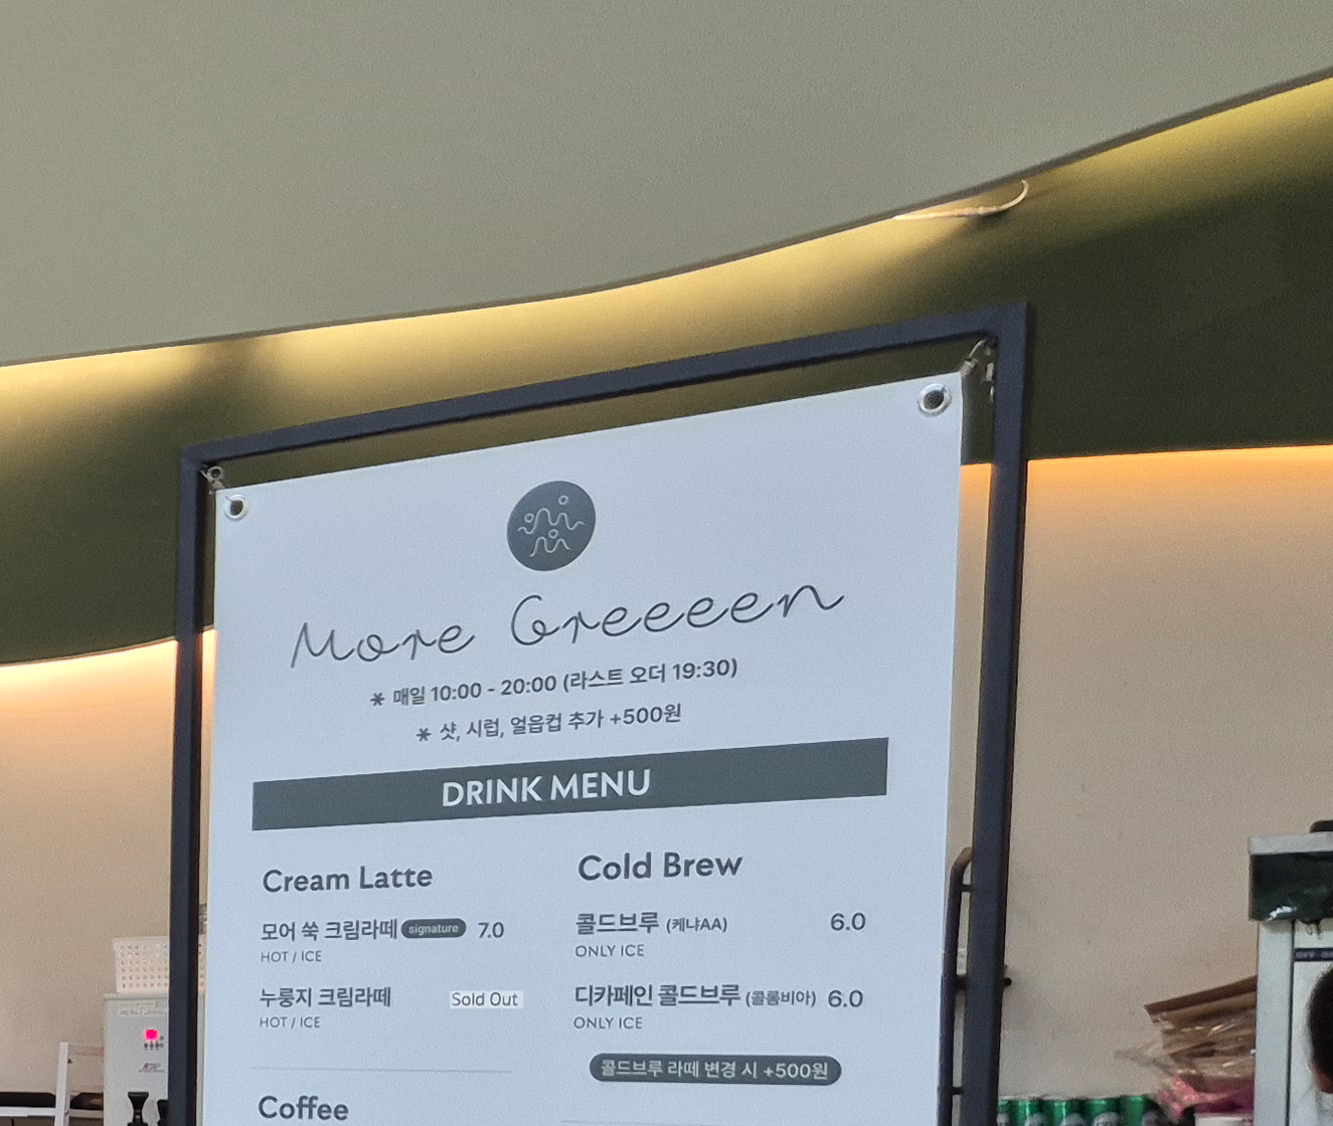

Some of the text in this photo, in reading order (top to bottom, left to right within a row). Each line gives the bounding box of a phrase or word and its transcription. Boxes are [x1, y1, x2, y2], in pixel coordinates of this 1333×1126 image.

[291, 585, 844, 668] More Greeeen
[394, 658, 737, 707] 매일 10:00 20:00 (라스트 오더 19:30)
[440, 722, 460, 742] 샷,
[466, 718, 504, 738] 시럽,
[568, 710, 604, 730] 추가
[610, 703, 681, 724] +500원
[443, 769, 650, 806] DRINK MENU
[579, 852, 742, 881] Cold Brew
[263, 866, 432, 892] Cream Latte
[261, 919, 504, 941] 모어 쑥 크림라떼 signature 7.0
[576, 912, 866, 935] 콜드브루 (케냐AA) 6.0
[261, 950, 321, 962] HOT ICE
[575, 944, 644, 957] ONLY ICE
[260, 987, 518, 1008] 누룽지 크림라떼 Sold Out
[576, 985, 863, 1007] 디카페인 콜드브루 (콜롬비아) 6.0
[602, 1060, 827, 1080] 콜드브루 라떼 변경 시 +500원
[259, 1096, 348, 1121] Coffee
